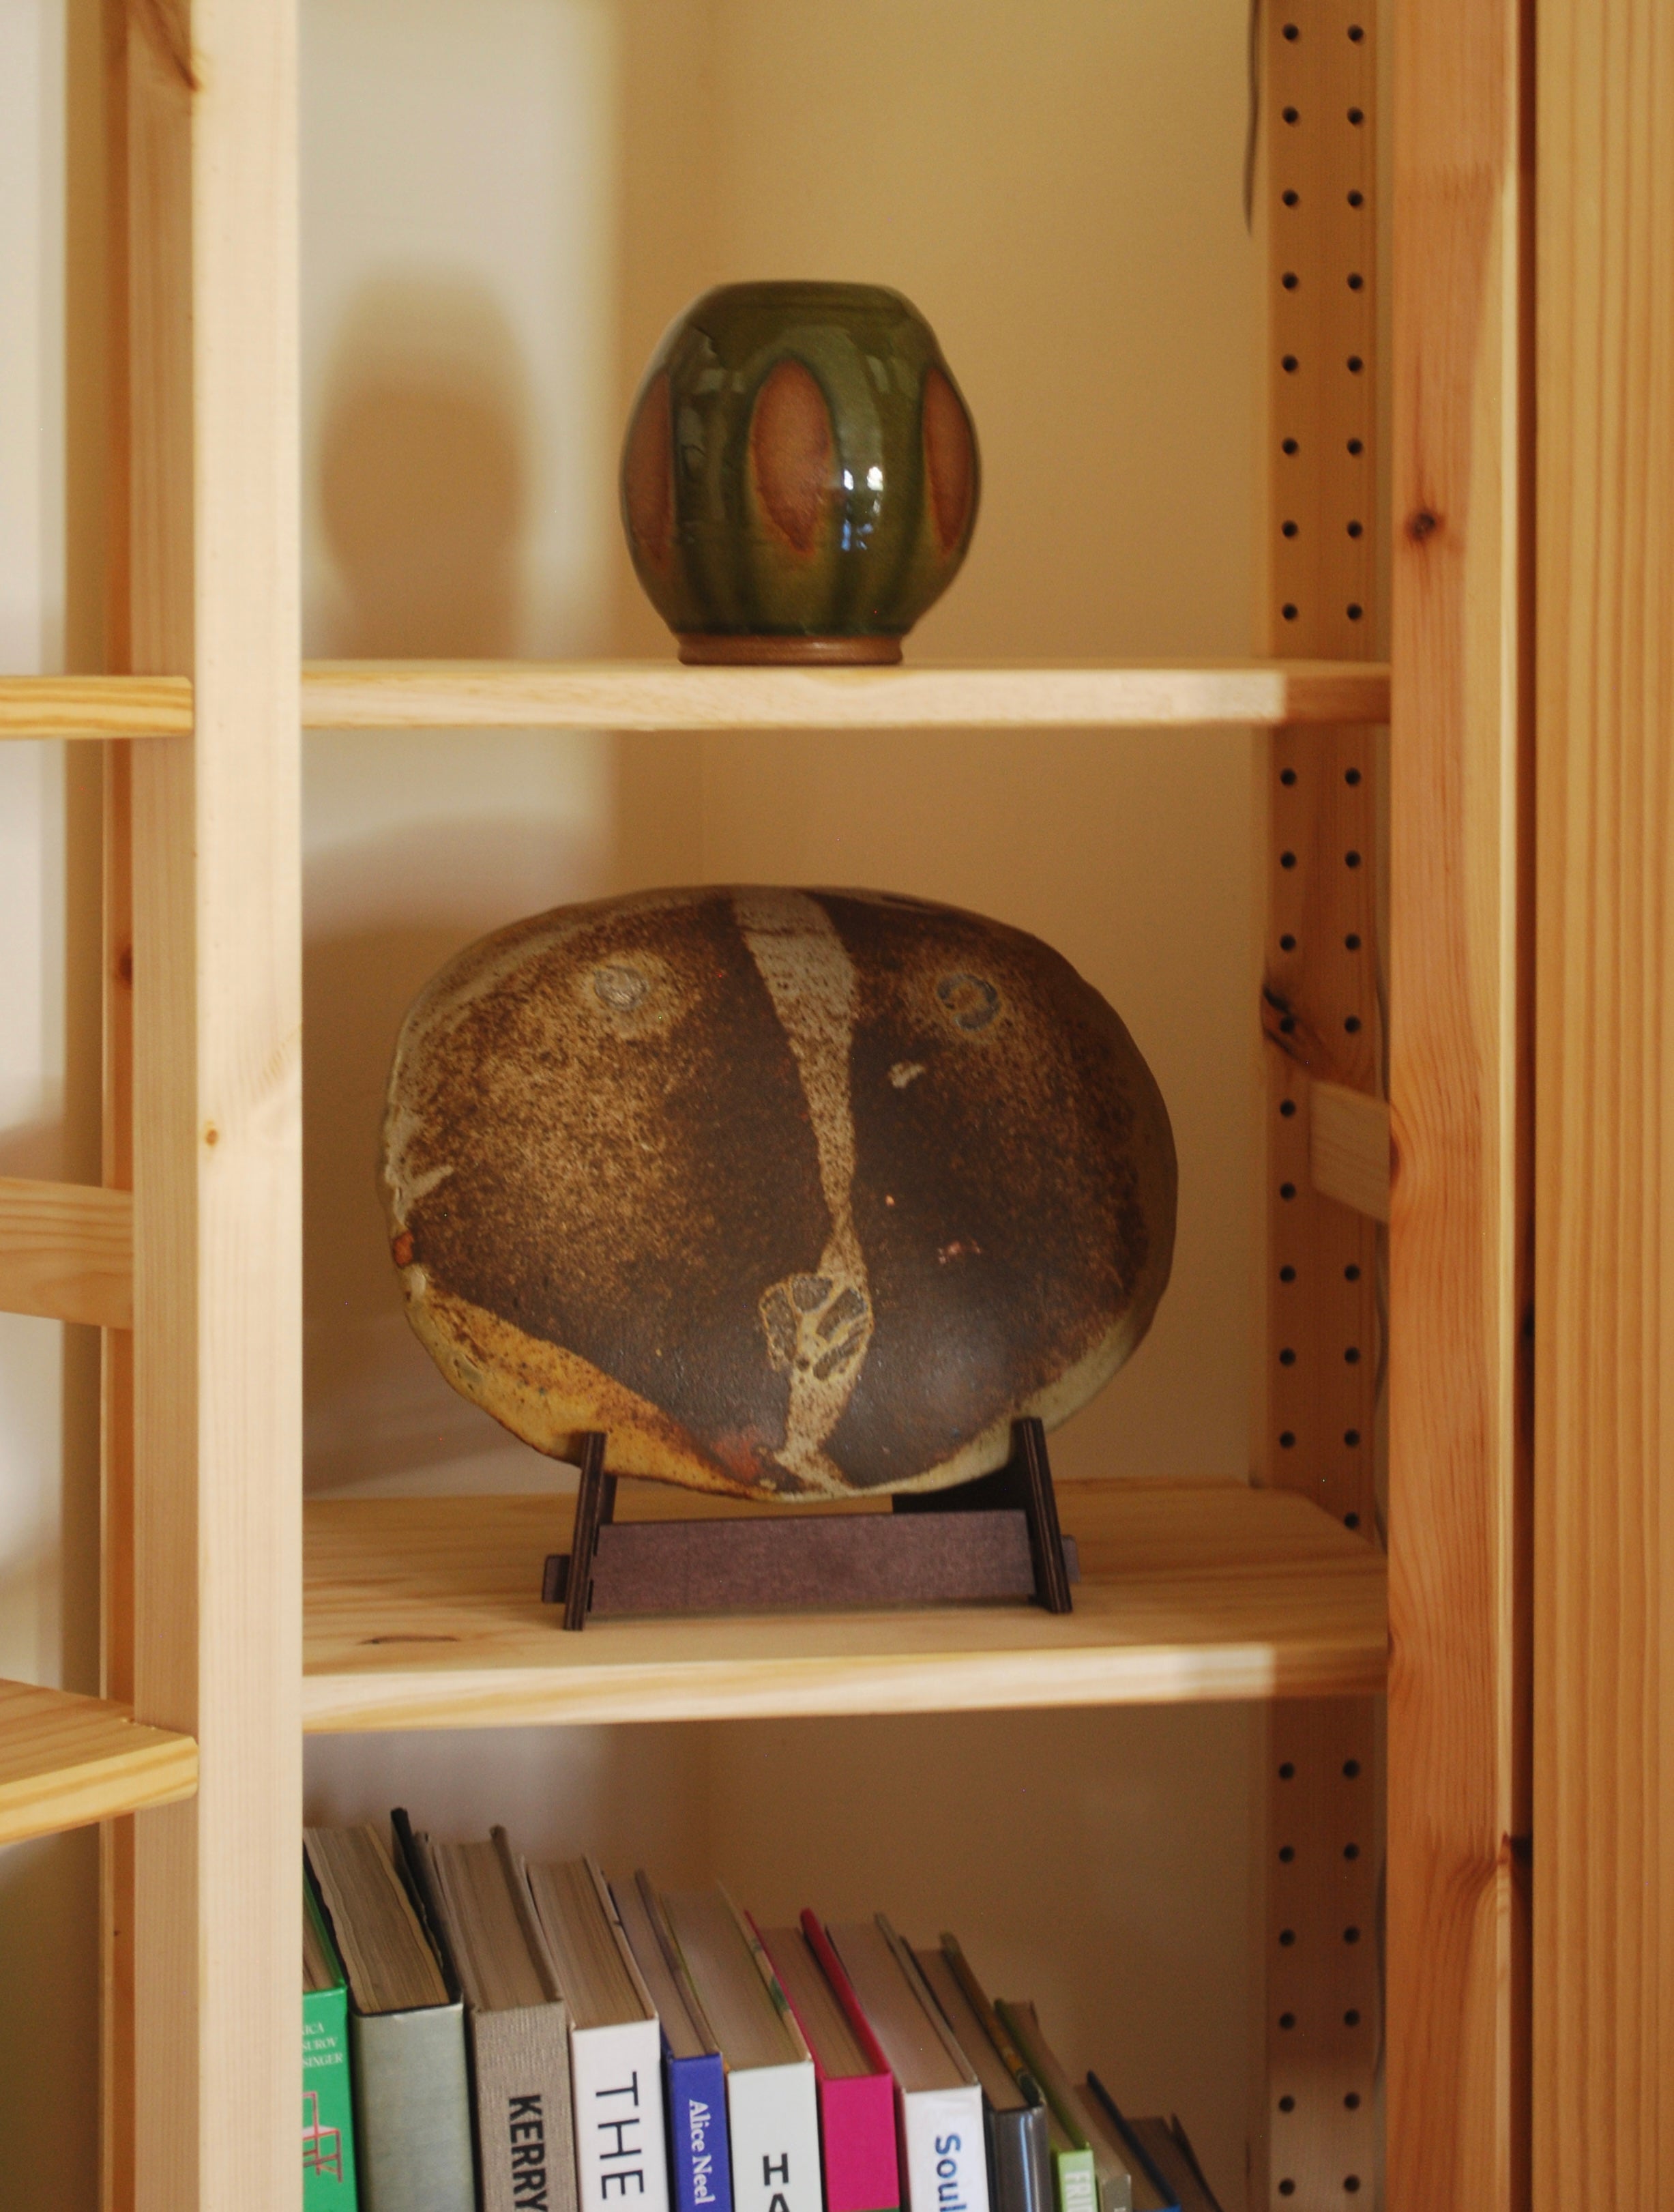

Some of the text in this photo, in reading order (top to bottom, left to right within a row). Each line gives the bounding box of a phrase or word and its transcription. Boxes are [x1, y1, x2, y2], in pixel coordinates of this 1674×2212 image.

[508, 2094, 548, 2212] KERRY
[596, 2071, 645, 2200] THE
[689, 2099, 716, 2205] Alice Neel
